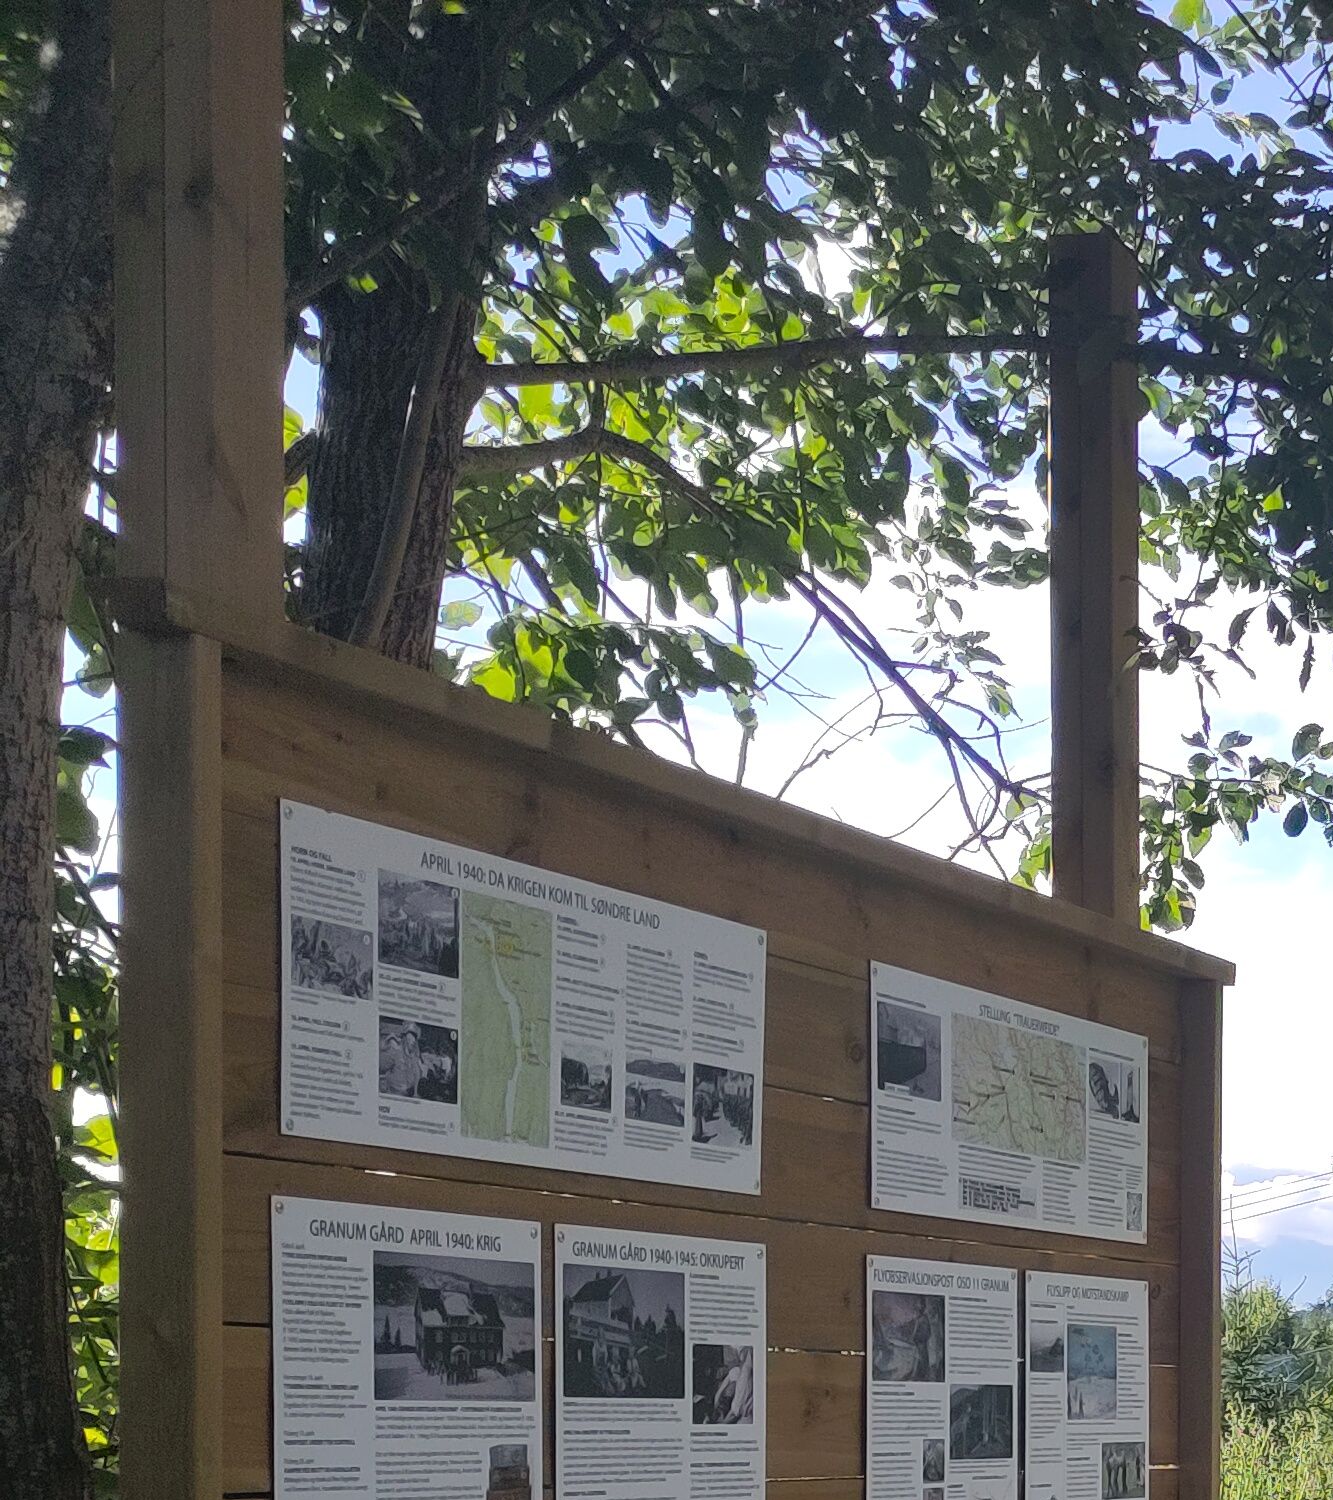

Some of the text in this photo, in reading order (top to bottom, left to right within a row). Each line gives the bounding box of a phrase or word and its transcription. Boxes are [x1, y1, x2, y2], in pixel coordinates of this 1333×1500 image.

[420, 851, 660, 930] APRIL 1940: DA KRIGEN KOM TIL SØNDRE LAND
[978, 1004, 1011, 1024] STELLING
[309, 1219, 501, 1252] GRANUM GÅRD APRIL 1940: KRIG
[572, 1241, 745, 1271] GRANUM GÅRD 1940-1945: OKKUPERT
[981, 1278, 1009, 1292] GRANUM
